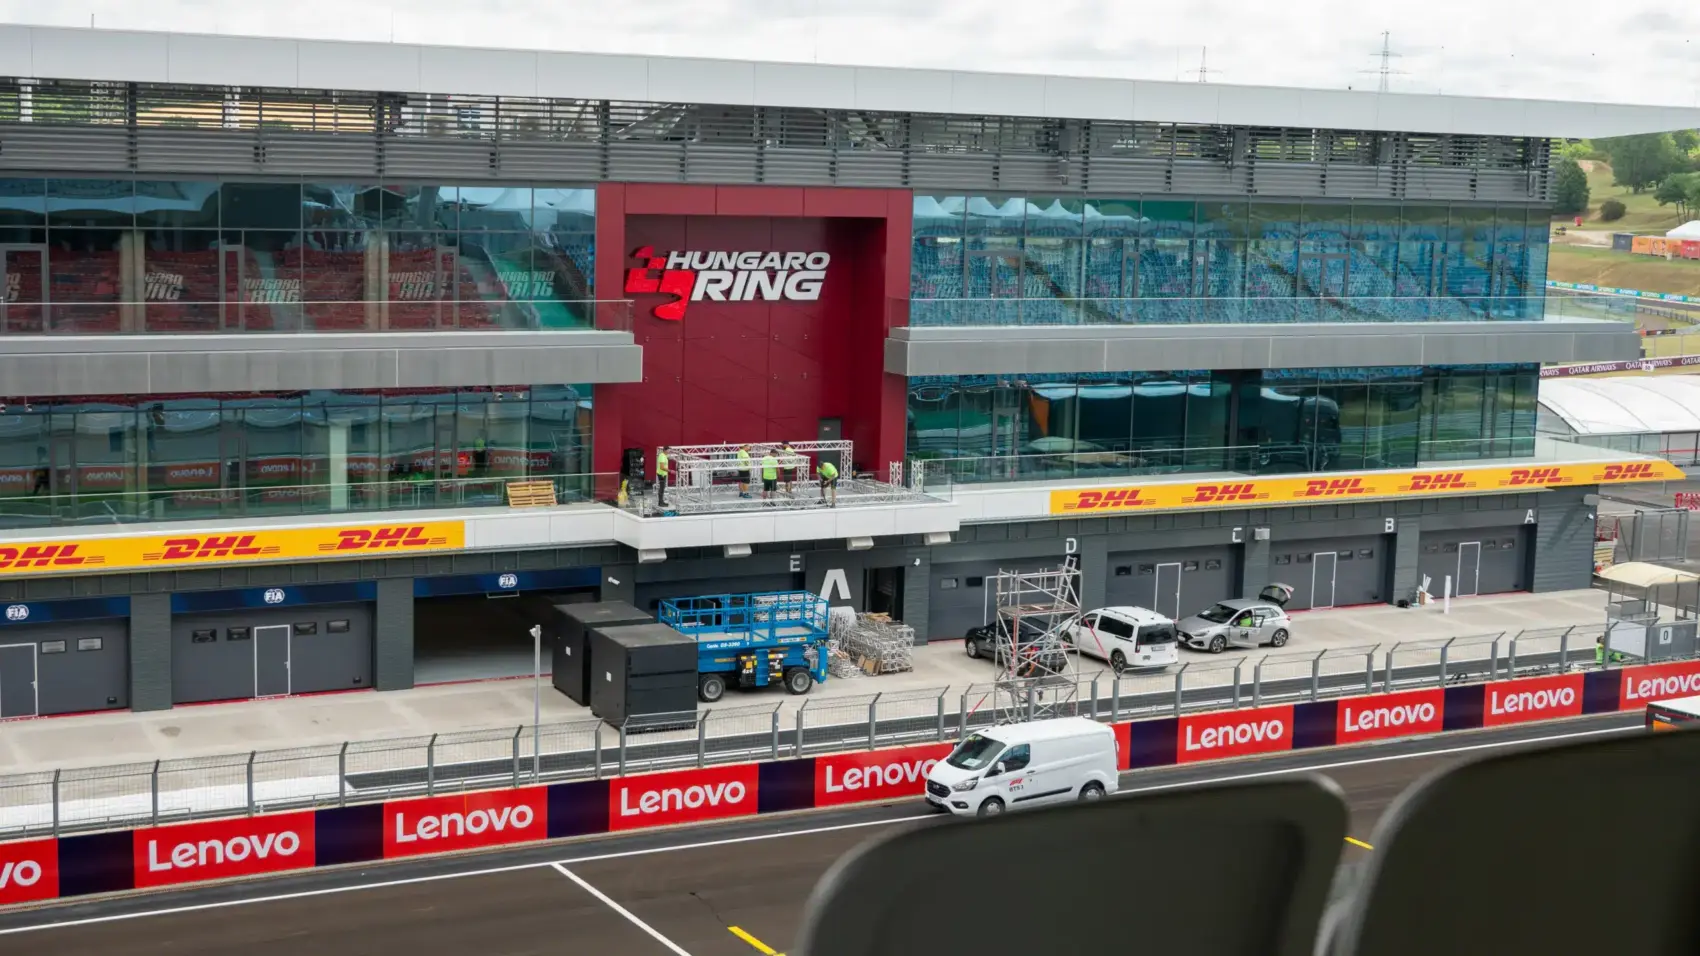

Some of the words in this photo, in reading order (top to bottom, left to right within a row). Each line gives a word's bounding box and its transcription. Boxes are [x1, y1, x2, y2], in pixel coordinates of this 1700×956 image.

[666, 251, 830, 270] HUNGARO
[691, 270, 827, 301] RING
[1568, 366, 1590, 375] QATAR
[1590, 364, 1617, 373] AIRWAYS
[1509, 468, 1562, 485] DHL
[1603, 464, 1654, 480] DHL
[1306, 478, 1364, 496] DHL
[1410, 473, 1465, 490] DHL
[1077, 490, 1143, 508] DHL
[1194, 484, 1257, 502] DHL
[1384, 517, 1395, 533] B
[1524, 509, 1535, 524] A
[336, 526, 429, 550] DHL
[1232, 527, 1242, 543] C
[162, 535, 261, 560] DHL
[1066, 537, 1077, 554] D
[0, 545, 85, 569] DHL
[789, 554, 801, 572] E
[499, 575, 516, 587] FIA
[265, 591, 283, 602] FIA
[7, 606, 28, 618] FIA
[1490, 688, 1576, 715] Lenovo
[1345, 703, 1436, 733] Lenovo
[1186, 719, 1284, 751] Lenovo
[620, 781, 746, 817] Lenovo
[396, 804, 534, 843] Lenovo
[148, 831, 300, 872] Lenovo
